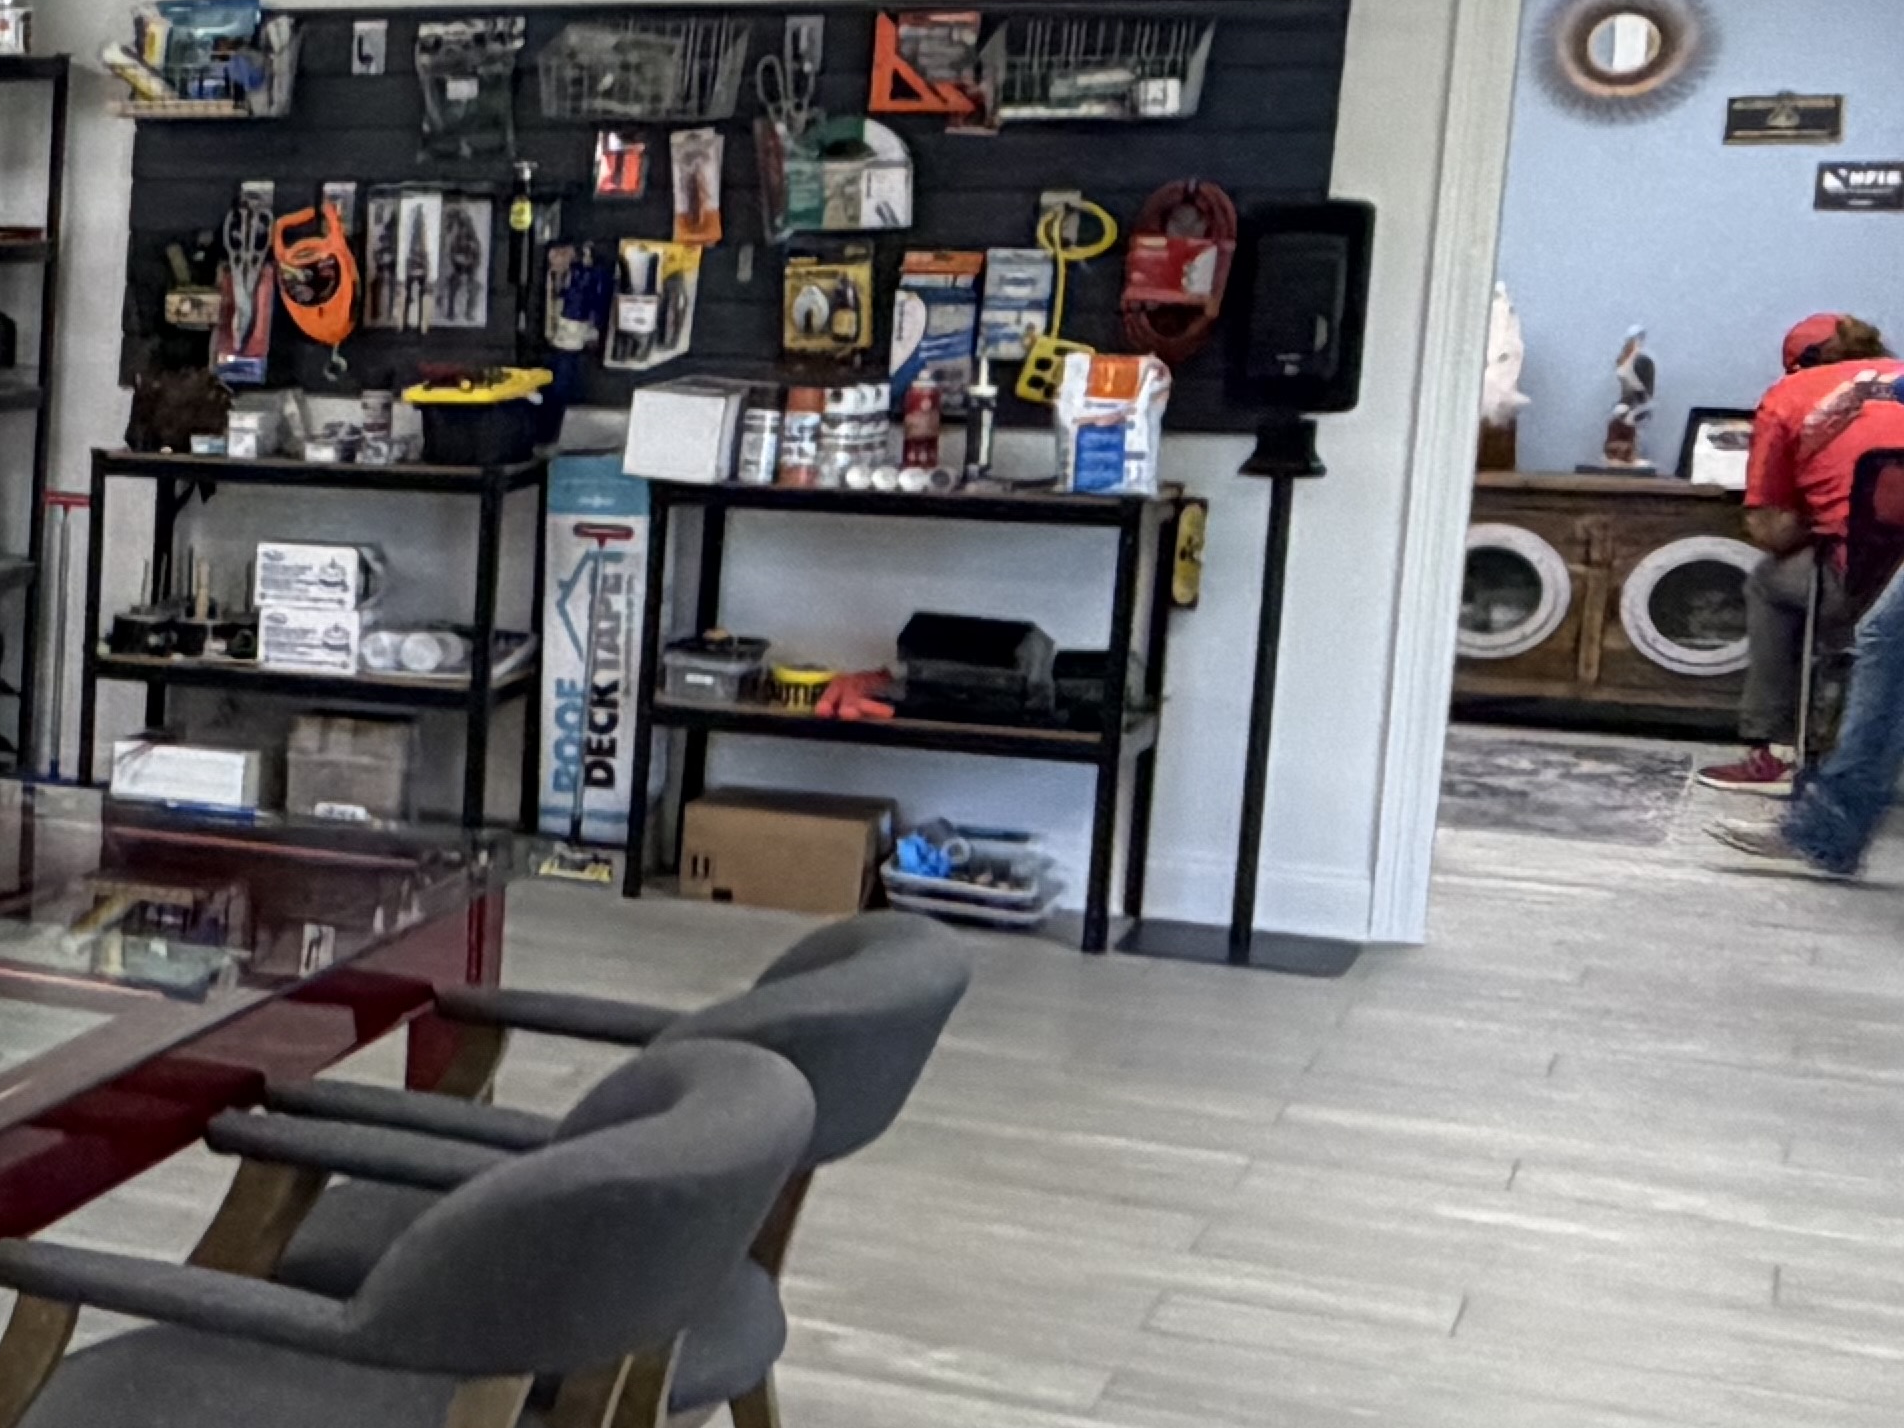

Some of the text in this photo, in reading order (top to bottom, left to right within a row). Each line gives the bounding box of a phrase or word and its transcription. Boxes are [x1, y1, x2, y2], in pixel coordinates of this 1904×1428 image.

[552, 678, 584, 792] ROOF
[584, 572, 623, 790] DECK TAPE
